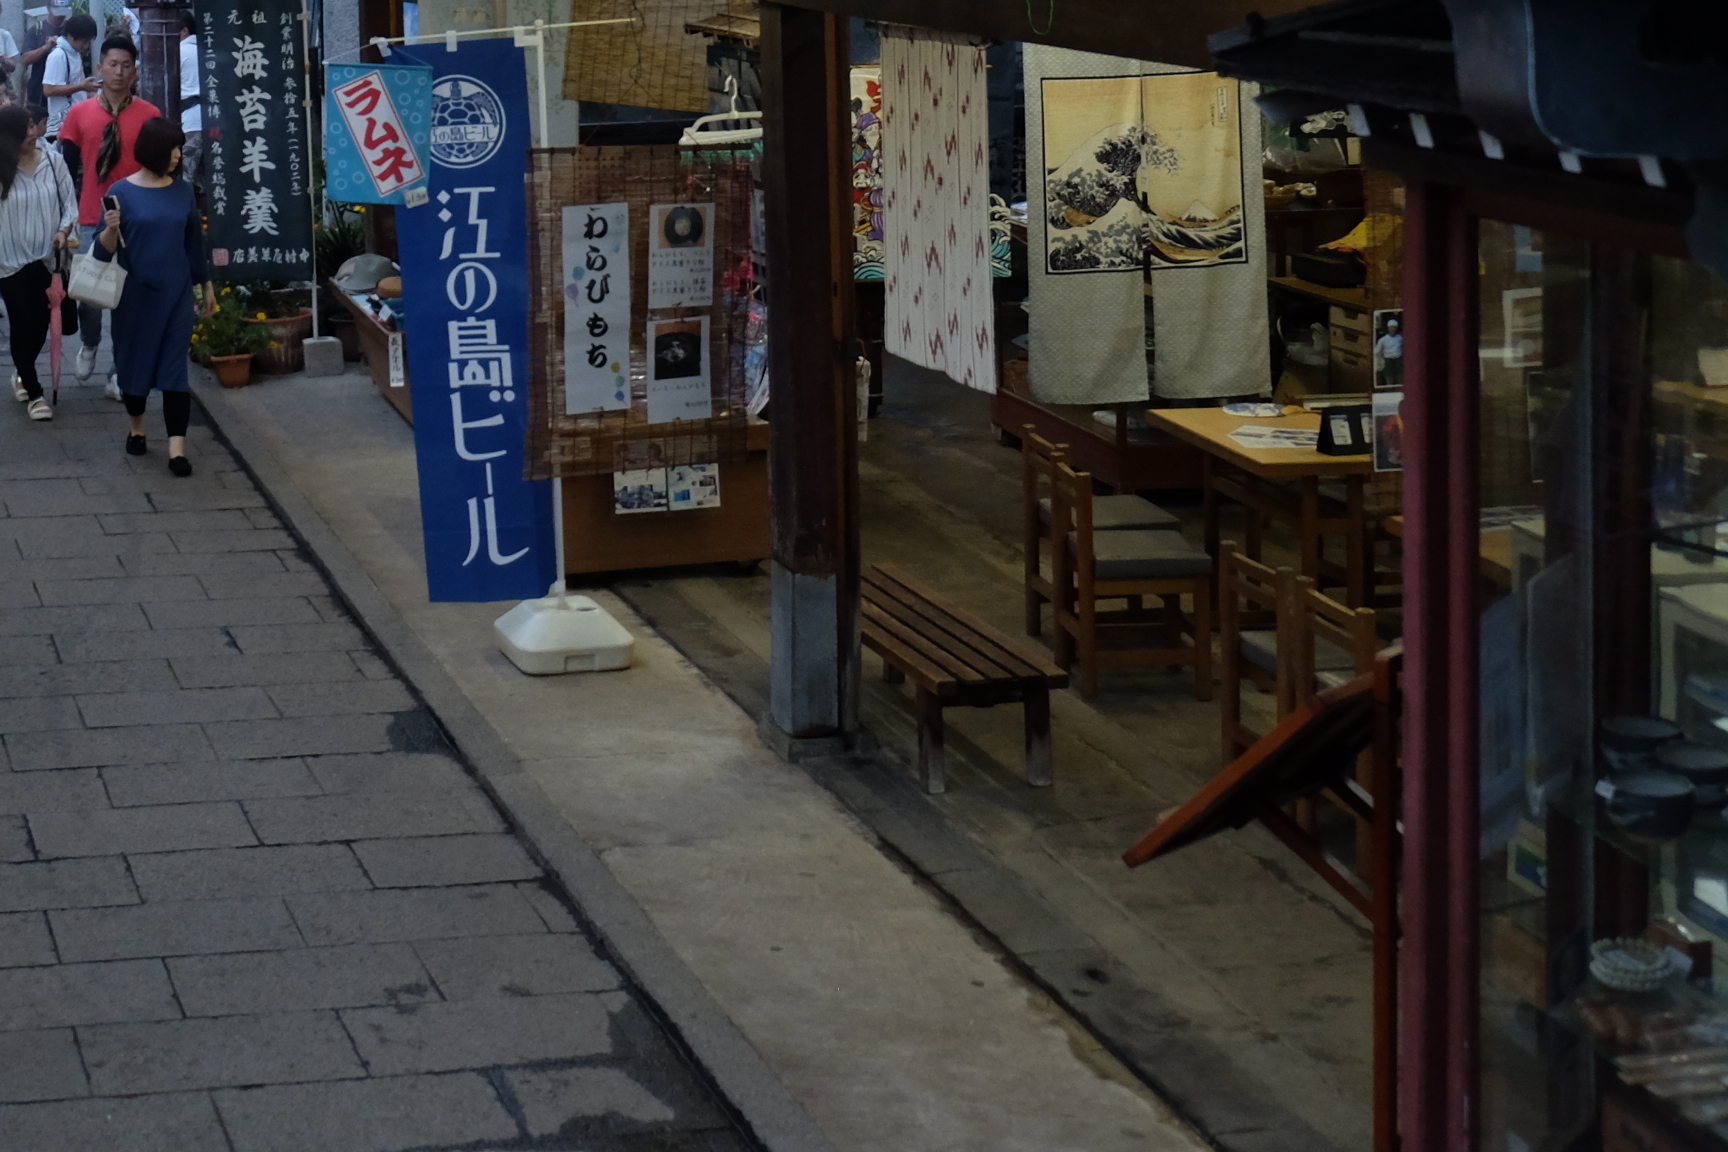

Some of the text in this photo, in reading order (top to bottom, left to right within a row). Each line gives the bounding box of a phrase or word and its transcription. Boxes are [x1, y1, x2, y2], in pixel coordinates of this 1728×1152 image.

[227, 9, 268, 25] 元祖
[231, 35, 279, 236] 海苔羊羹
[343, 80, 414, 184] ラムネ
[583, 212, 611, 369] わらびもち
[436, 186, 530, 567] 江の島ビール
